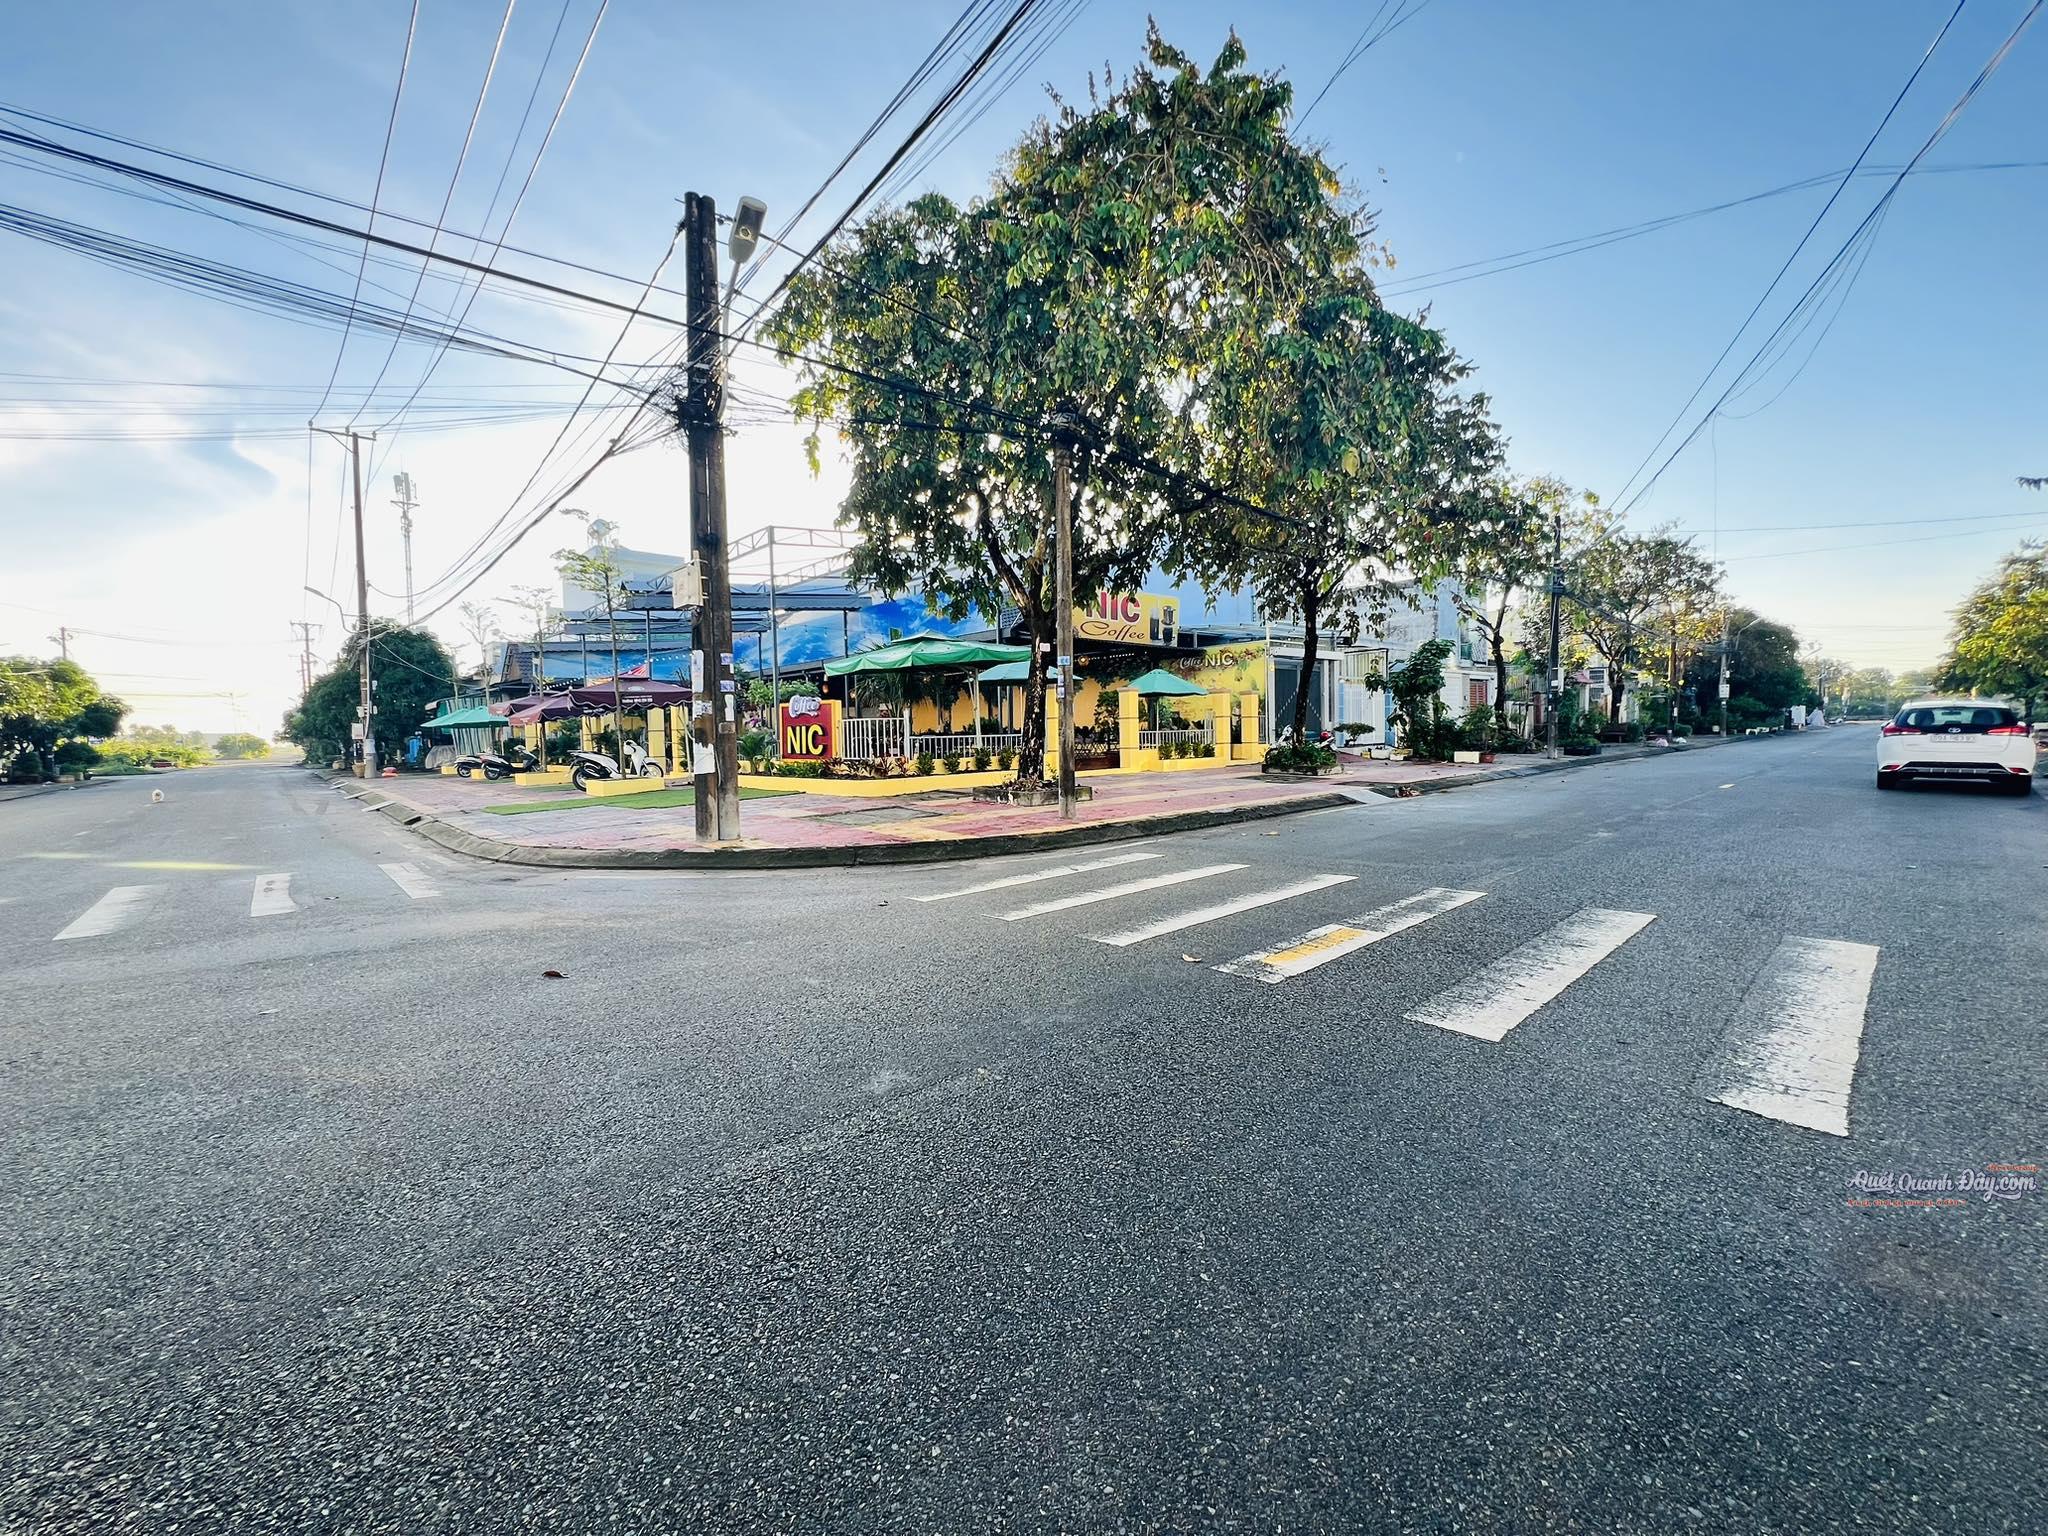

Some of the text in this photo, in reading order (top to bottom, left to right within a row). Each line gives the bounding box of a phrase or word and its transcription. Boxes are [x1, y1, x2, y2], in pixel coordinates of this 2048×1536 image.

[1086, 591, 1141, 623] NIC
[1079, 621, 1146, 641] Coffee
[1204, 653, 1234, 667] NIC
[787, 724, 824, 755] NIC
